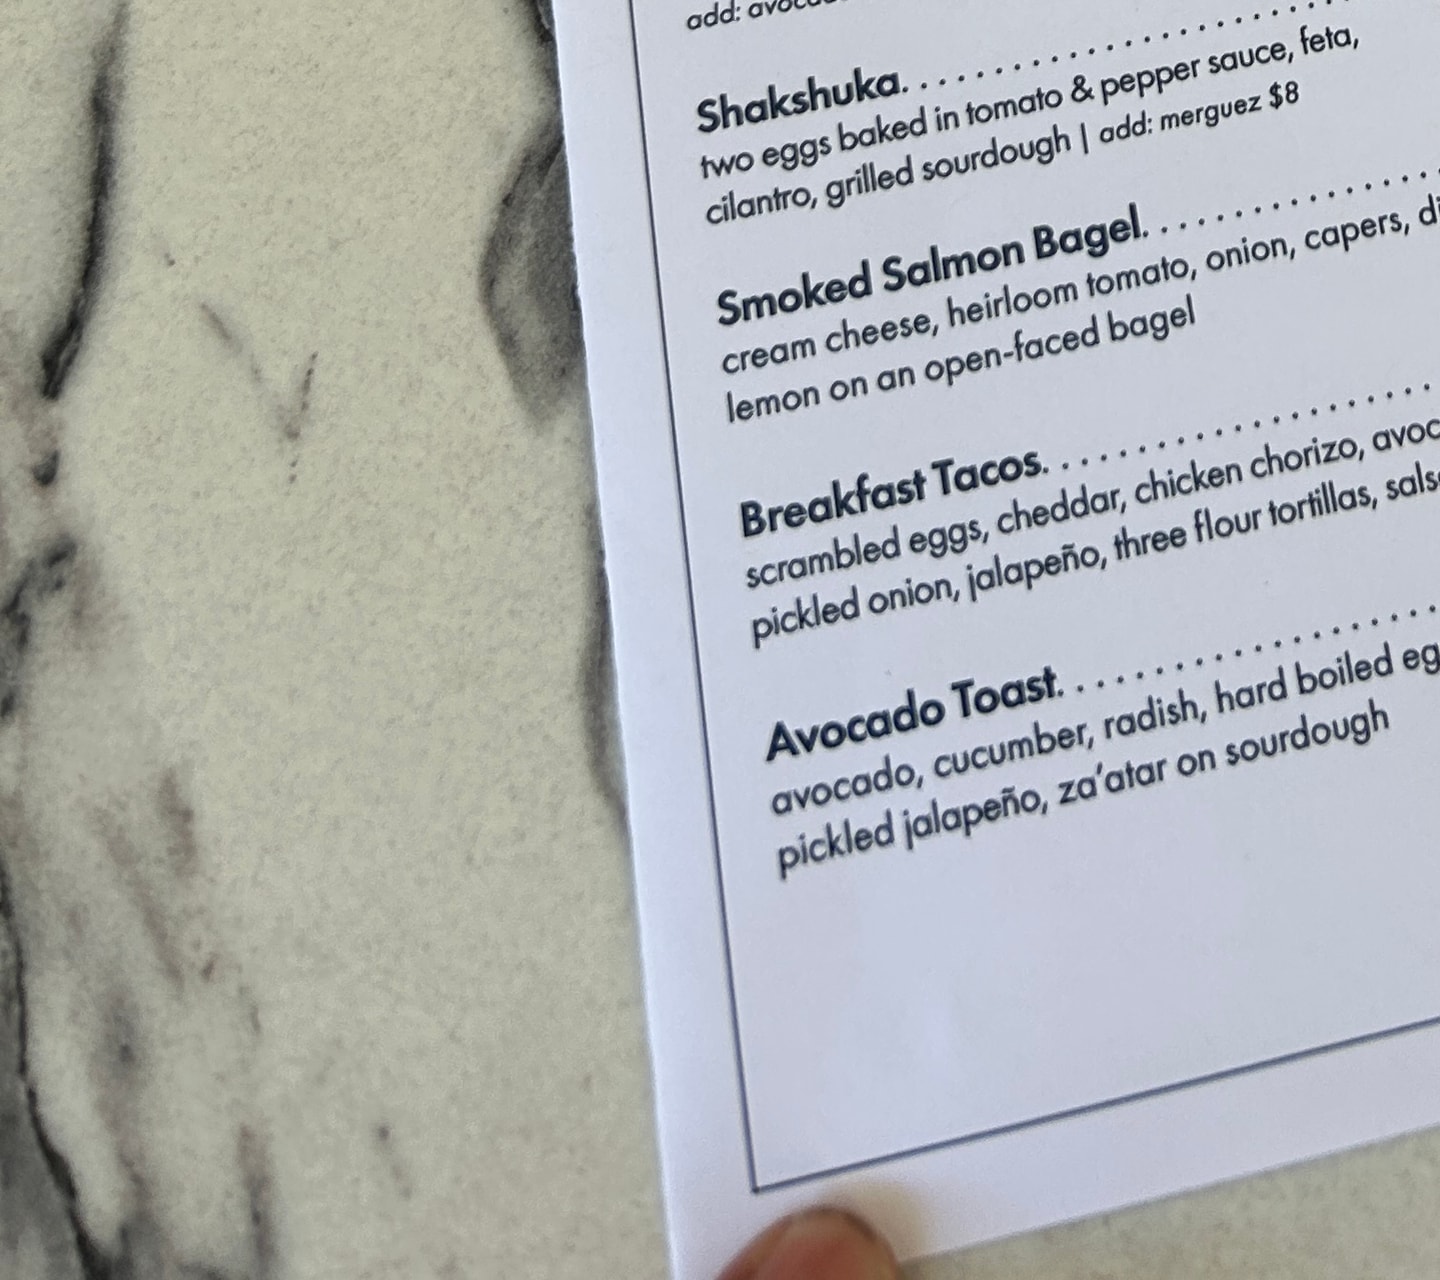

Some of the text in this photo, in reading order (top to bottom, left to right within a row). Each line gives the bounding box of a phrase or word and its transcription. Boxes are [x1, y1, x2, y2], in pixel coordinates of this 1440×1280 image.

[696, 66, 901, 134] Shakshuka
[700, 24, 1359, 180] two eggs baked in tomato & pepper sauce, feta,
[717, 258, 873, 327] Smoked
[881, 241, 1026, 293] Salmon
[1032, 201, 1142, 261] Bagel
[721, 337, 817, 375] cream
[825, 313, 939, 354] cheese,
[946, 282, 1079, 328] heirloom
[1085, 255, 1197, 298] tomato,
[1205, 236, 1296, 272] onion,
[1304, 212, 1410, 253] capers,
[726, 293, 1196, 424] lemon on an open-faced bagel
[739, 469, 928, 539] Breakfast
[930, 451, 1043, 496] Tacos
[746, 524, 902, 590] scrambled
[908, 519, 990, 560] eggs,
[996, 483, 1127, 535] cheddar,
[1134, 459, 1243, 505] chicken
[1250, 436, 1365, 480] chorizo,
[765, 688, 946, 763] Avocado
[950, 665, 1057, 719] Toast
[777, 697, 1390, 881] pickled jalapeño, za'atar on sourdough
